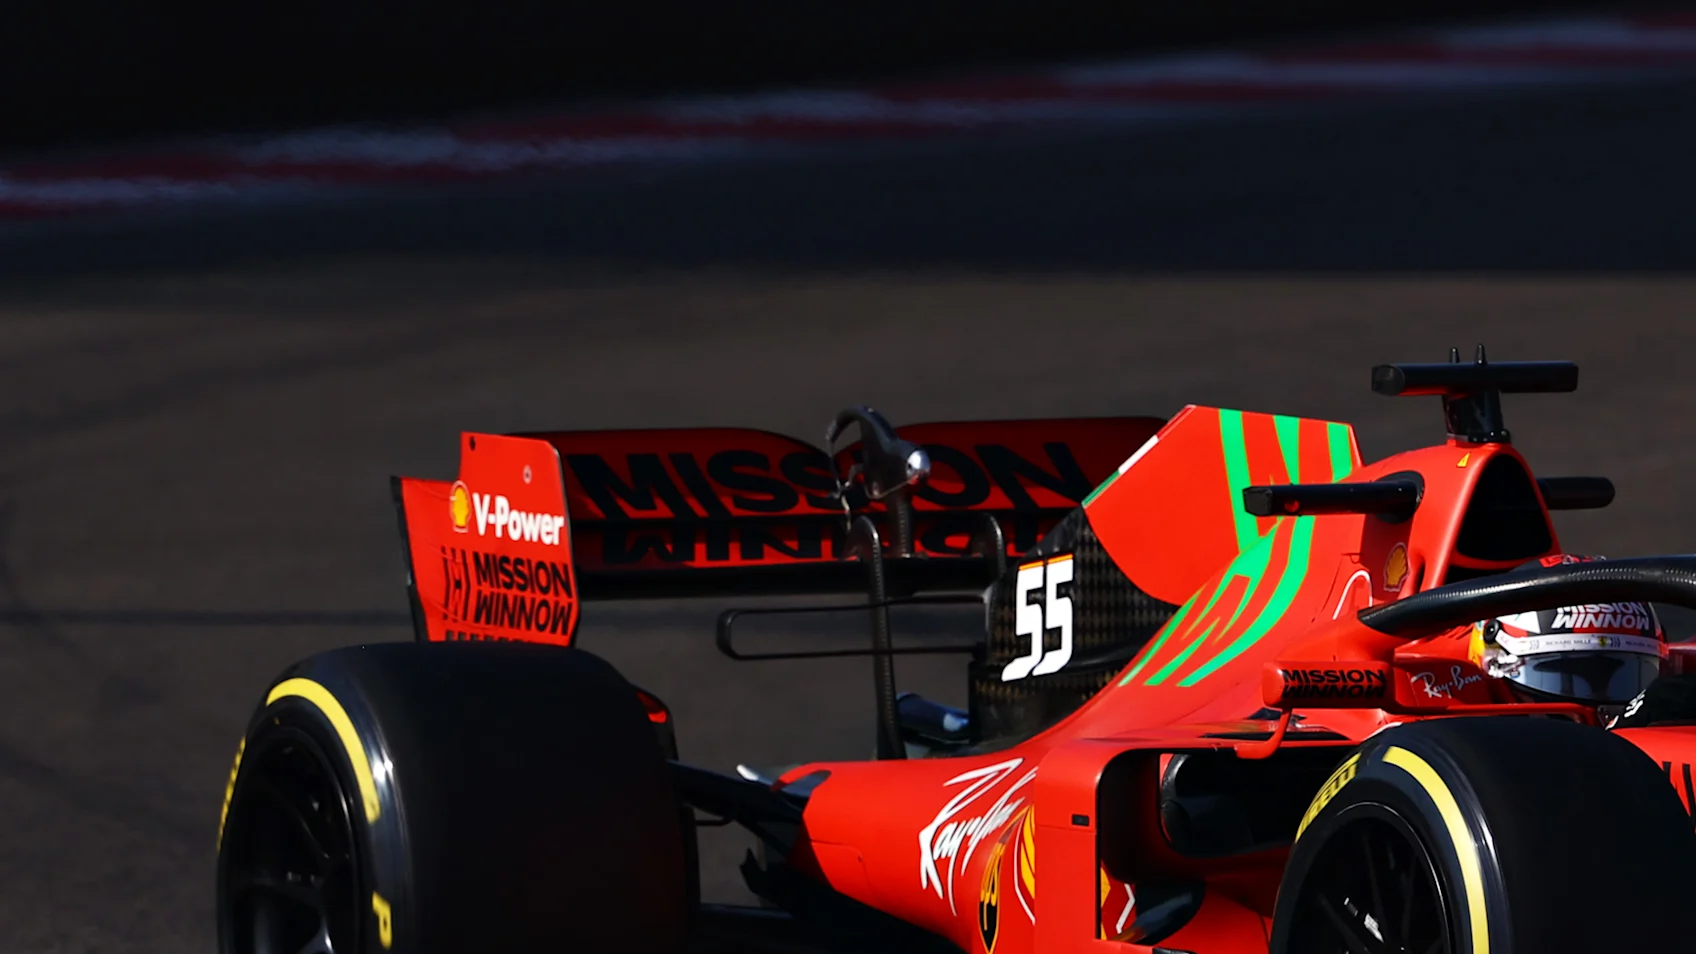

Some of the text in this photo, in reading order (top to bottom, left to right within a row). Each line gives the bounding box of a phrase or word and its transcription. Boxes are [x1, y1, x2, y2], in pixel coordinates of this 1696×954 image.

[567, 443, 1093, 520] MISSON
[472, 492, 564, 546] V-Power
[473, 551, 573, 599] MISSION
[474, 589, 572, 636] WINNOW
[1001, 556, 1074, 682] 55
[1551, 612, 1650, 631] WINNOW
[1281, 683, 1386, 700] WINNOW
[1282, 669, 1386, 684] MISSION
[1410, 665, 1482, 699] Ray-Ban
[372, 892, 393, 949] P
